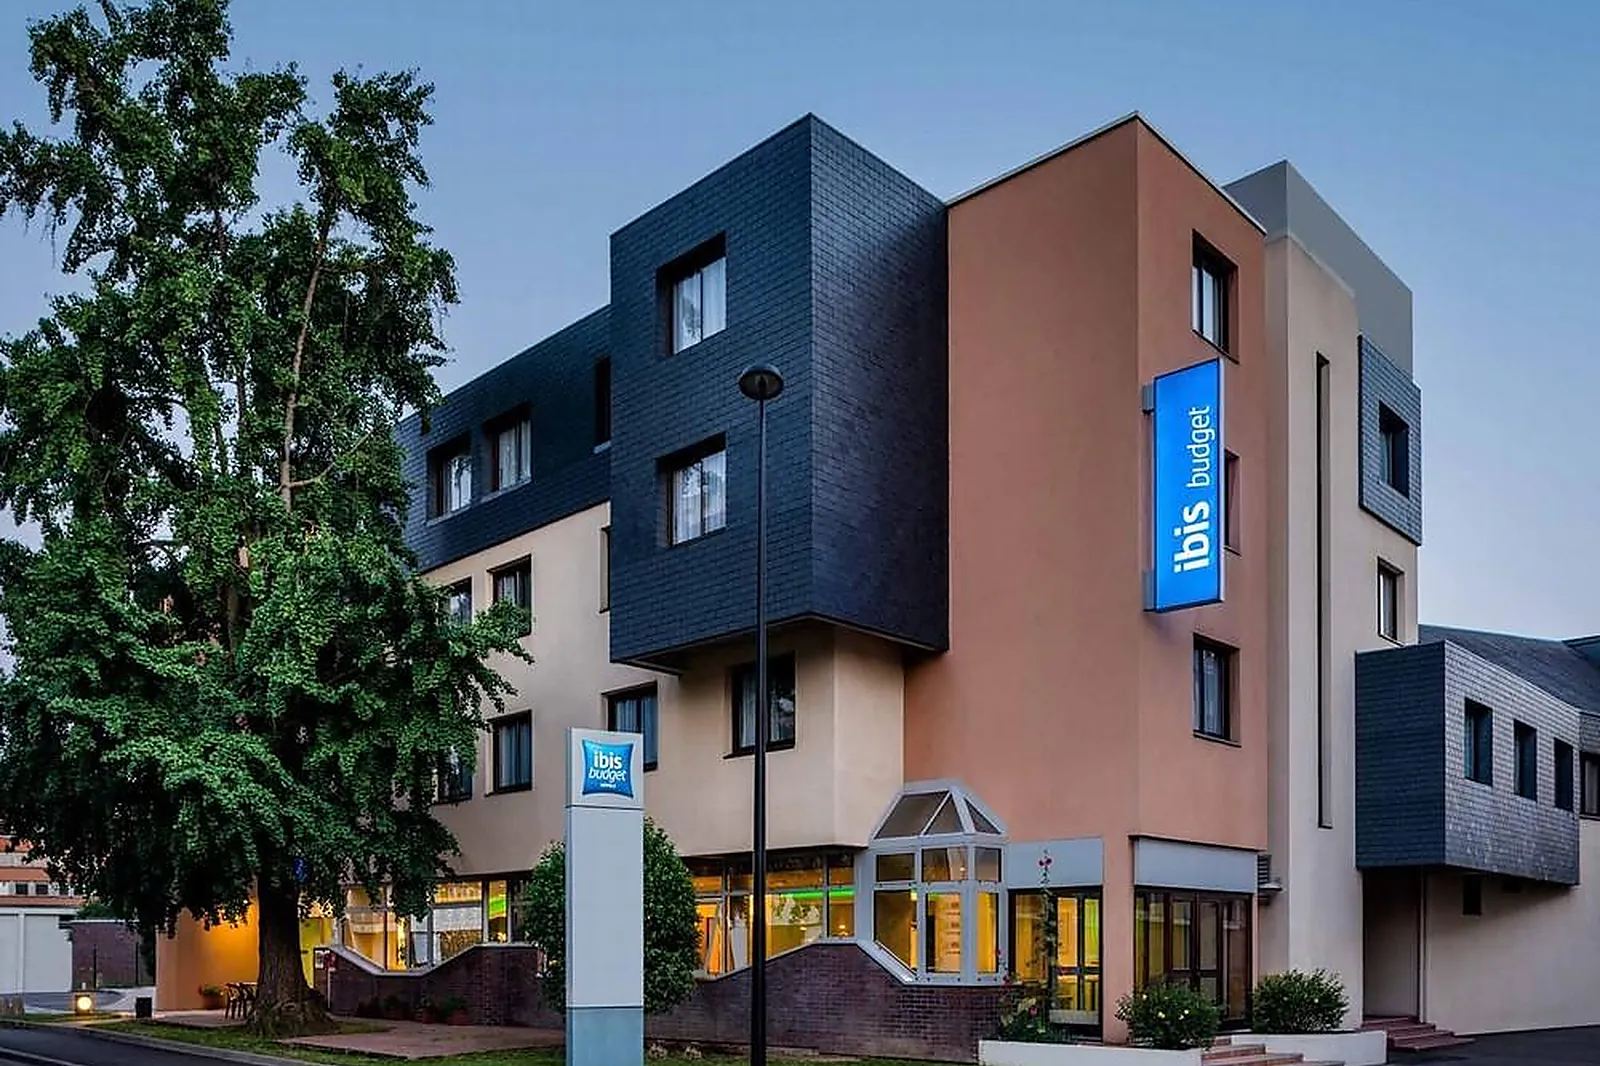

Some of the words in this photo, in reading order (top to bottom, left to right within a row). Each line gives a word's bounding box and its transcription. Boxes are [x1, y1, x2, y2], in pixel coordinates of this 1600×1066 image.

[1186, 406, 1216, 488] budget
[1174, 501, 1210, 573] ibis
[588, 767, 627, 783] budget
[593, 750, 623, 769] ibis
